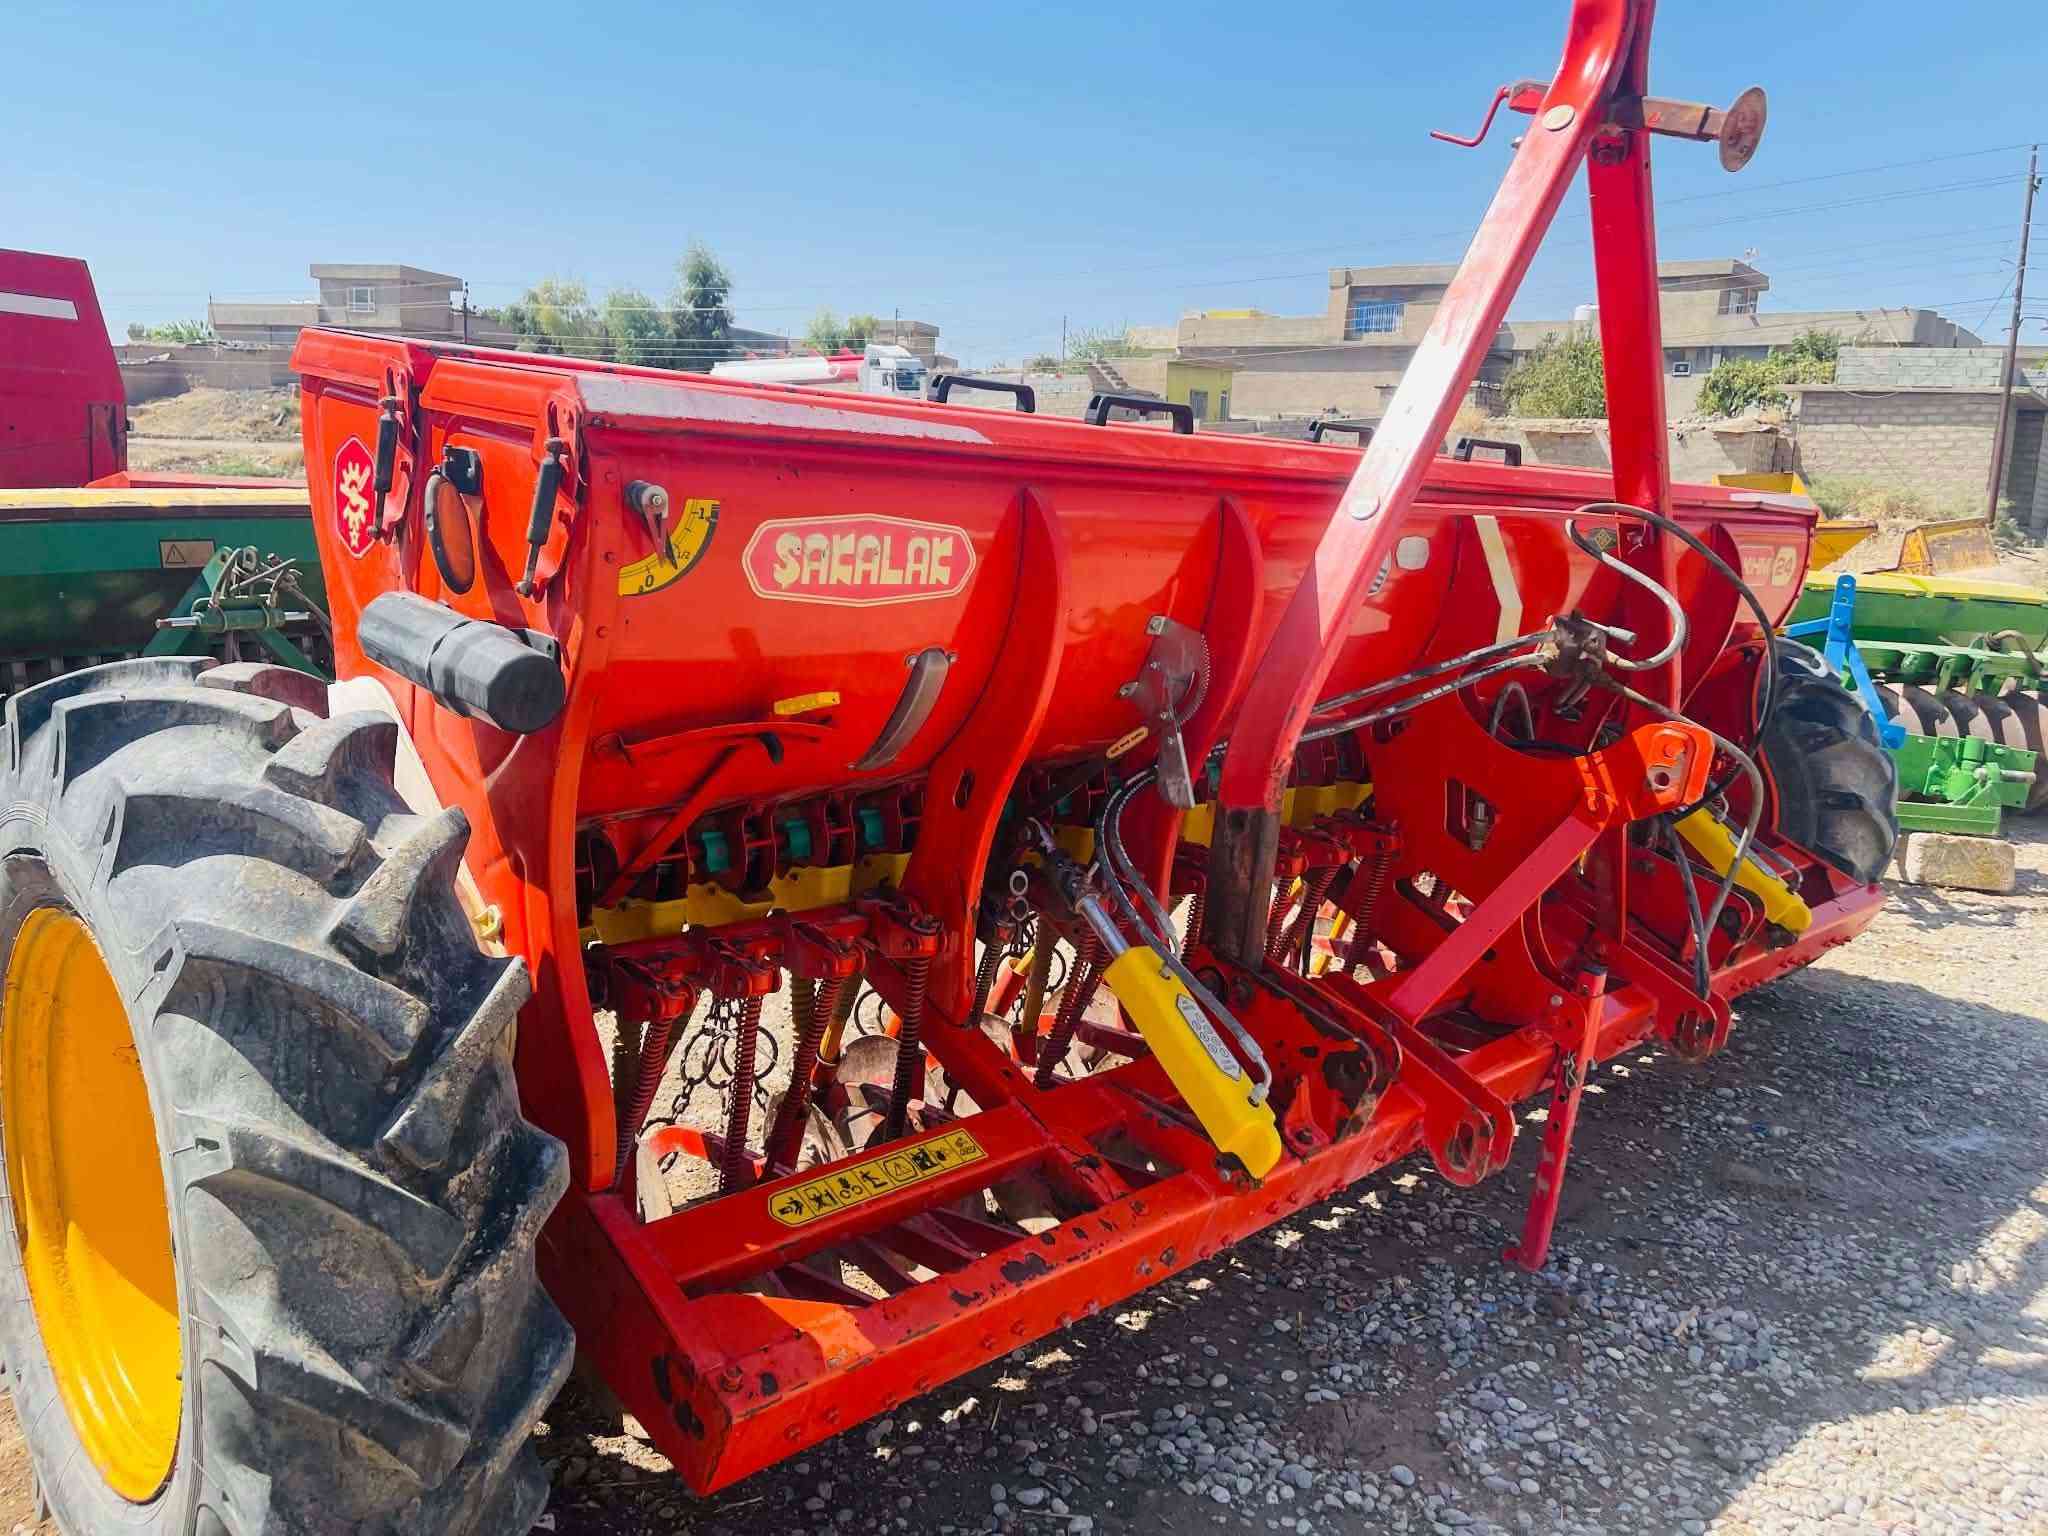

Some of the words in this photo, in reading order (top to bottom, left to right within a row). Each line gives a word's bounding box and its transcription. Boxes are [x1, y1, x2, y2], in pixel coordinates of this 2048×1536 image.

[772, 531, 954, 590] SAKALAK
[1775, 557, 1793, 577] 24
[645, 574, 655, 588] 0
